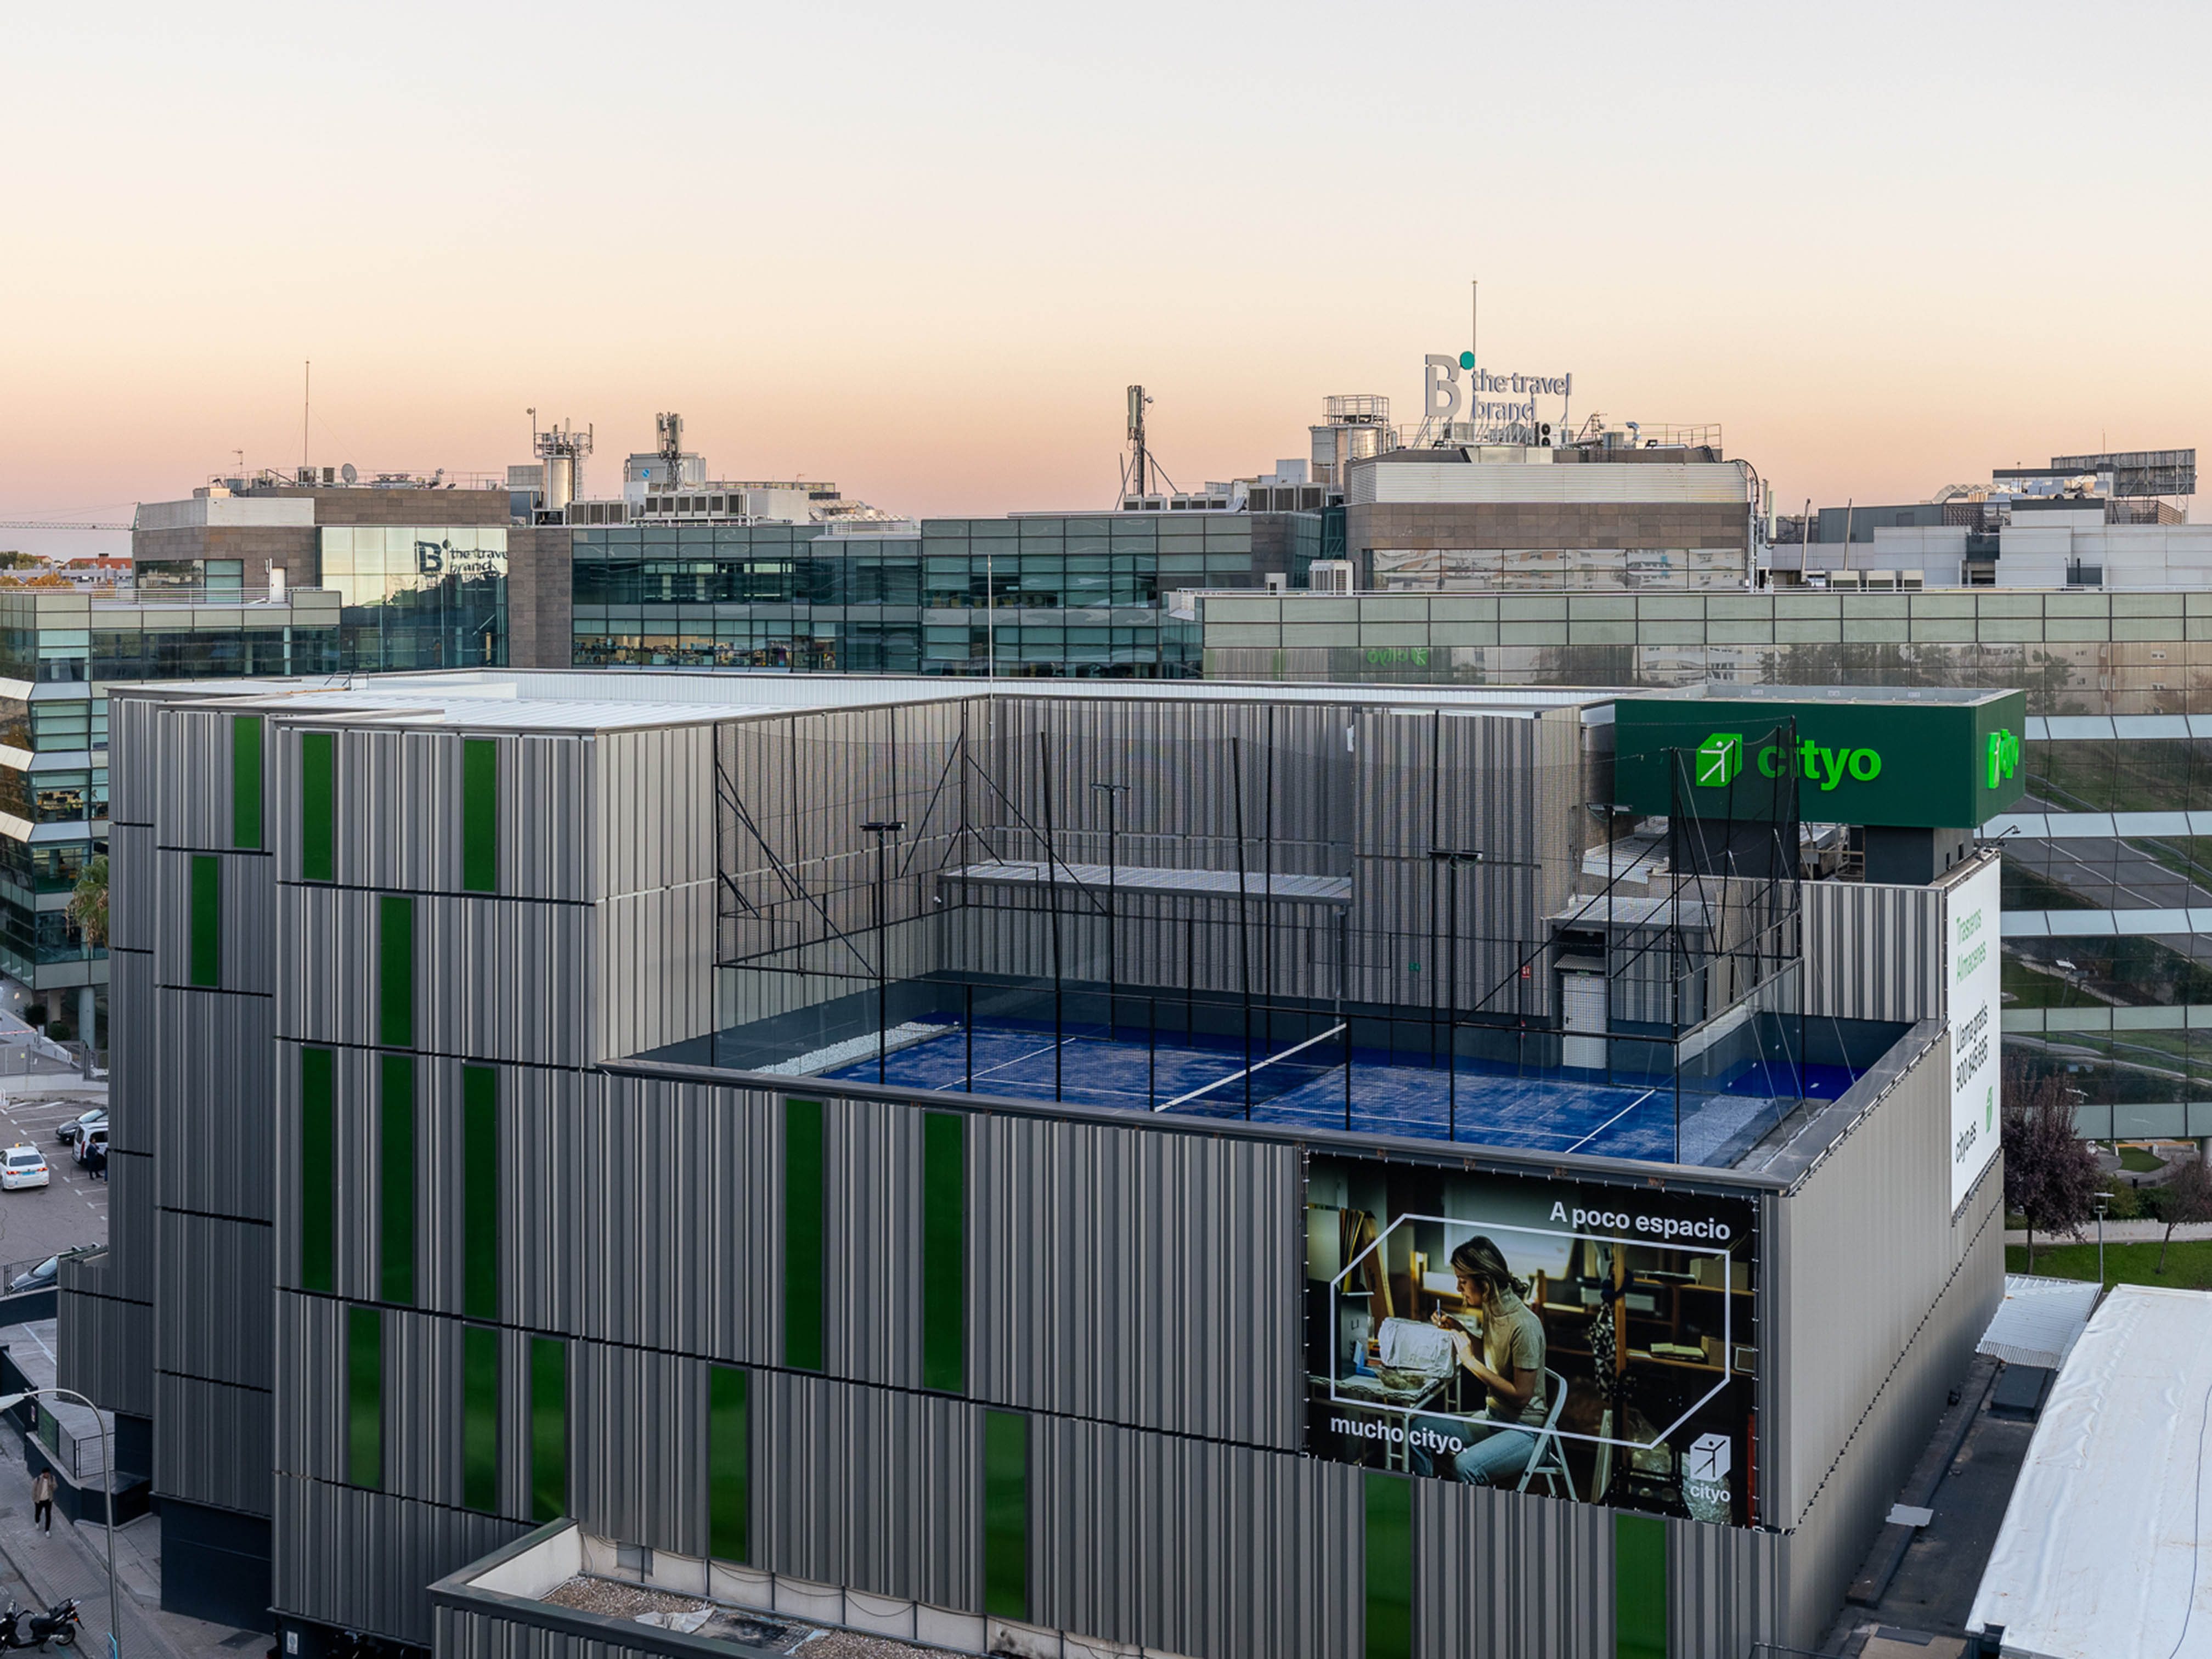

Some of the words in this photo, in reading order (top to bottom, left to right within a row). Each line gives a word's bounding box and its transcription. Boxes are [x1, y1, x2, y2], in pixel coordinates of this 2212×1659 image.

[1471, 368, 1508, 393] the
[1510, 372, 1572, 396] travel
[1472, 394, 1537, 421] brand
[449, 548, 470, 559] the
[1757, 735, 1882, 791] cityo
[1956, 908, 1982, 945] Trasteros
[1956, 941, 1986, 985] Almacenes
[1956, 1020, 1973, 1054] Llama
[1973, 1000, 1988, 1043] gratis
[1956, 1057, 1968, 1093] 900
[1955, 1120, 1976, 1164] cityo.es
[1549, 1201, 1567, 1222] A
[1572, 1208, 1630, 1229] poco
[1635, 1215, 1731, 1240] espacio
[1330, 1417, 1404, 1443] mucho
[1409, 1426, 1468, 1454] cityo.
[1690, 1482, 1731, 1504] cityo
